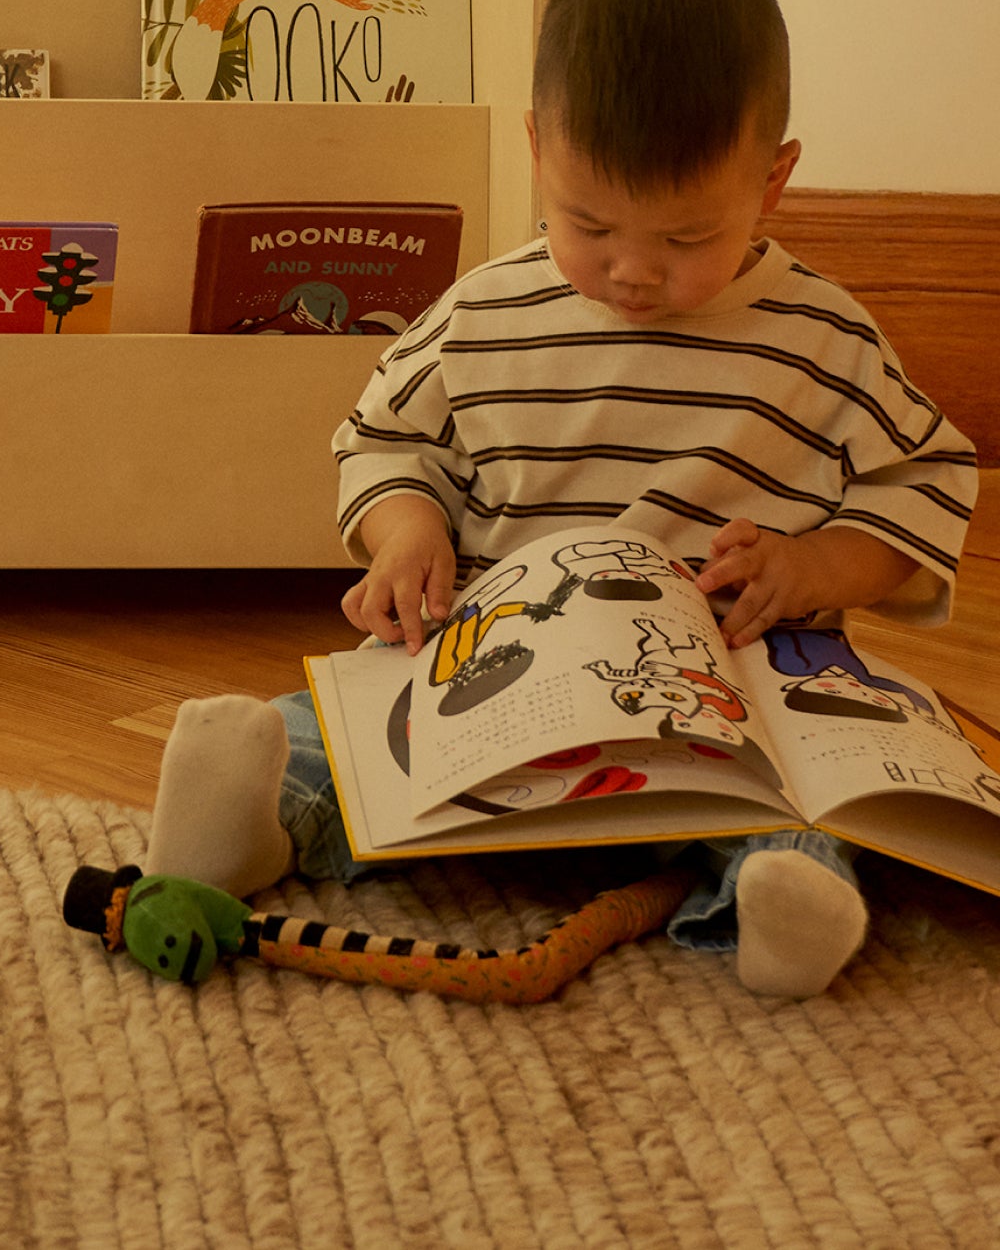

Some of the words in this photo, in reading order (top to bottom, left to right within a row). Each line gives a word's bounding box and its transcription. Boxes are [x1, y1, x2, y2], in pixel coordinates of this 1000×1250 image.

[250, 227, 426, 256] MOONBEAM
[264, 261, 311, 274] AND
[321, 261, 398, 276] SUNNY
